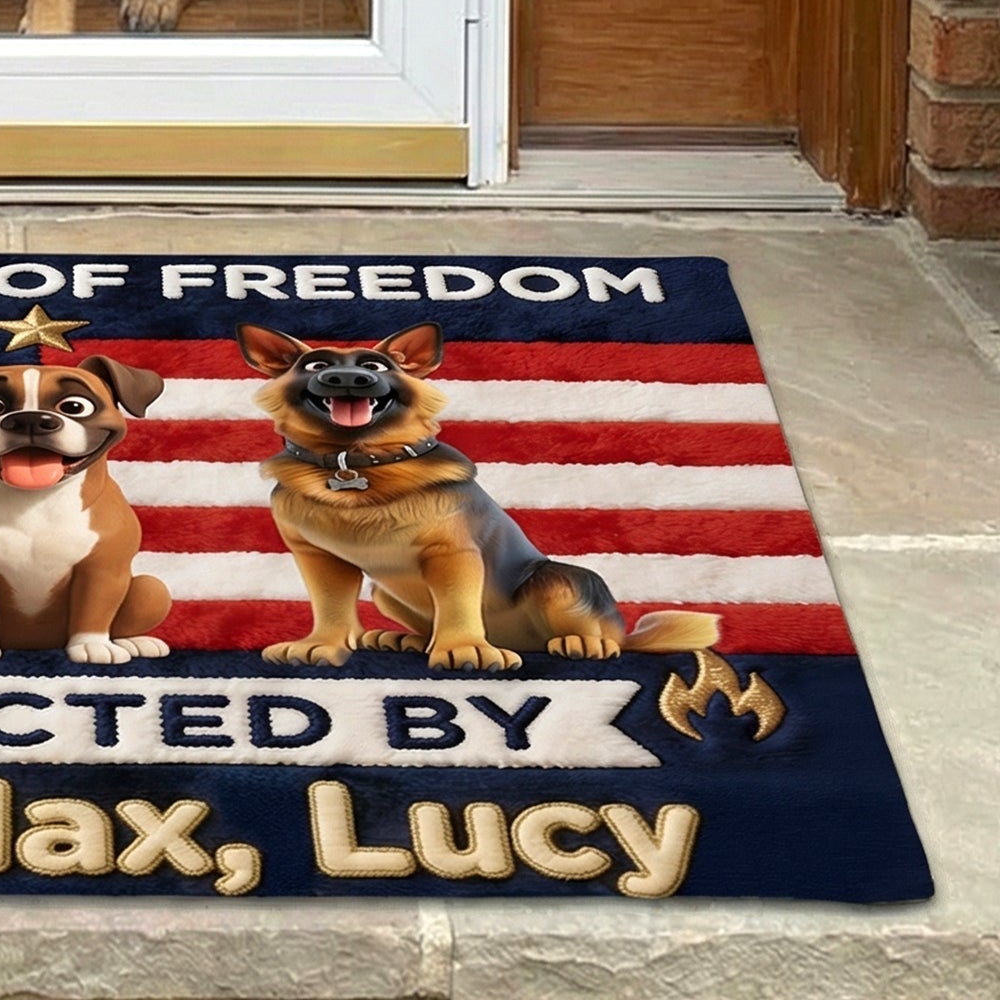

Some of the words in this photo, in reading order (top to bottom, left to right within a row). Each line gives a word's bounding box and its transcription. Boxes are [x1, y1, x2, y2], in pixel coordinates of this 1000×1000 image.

[161, 264, 666, 303] FREEDOM
[384, 695, 552, 751] BY
[308, 780, 699, 898] Lucy
